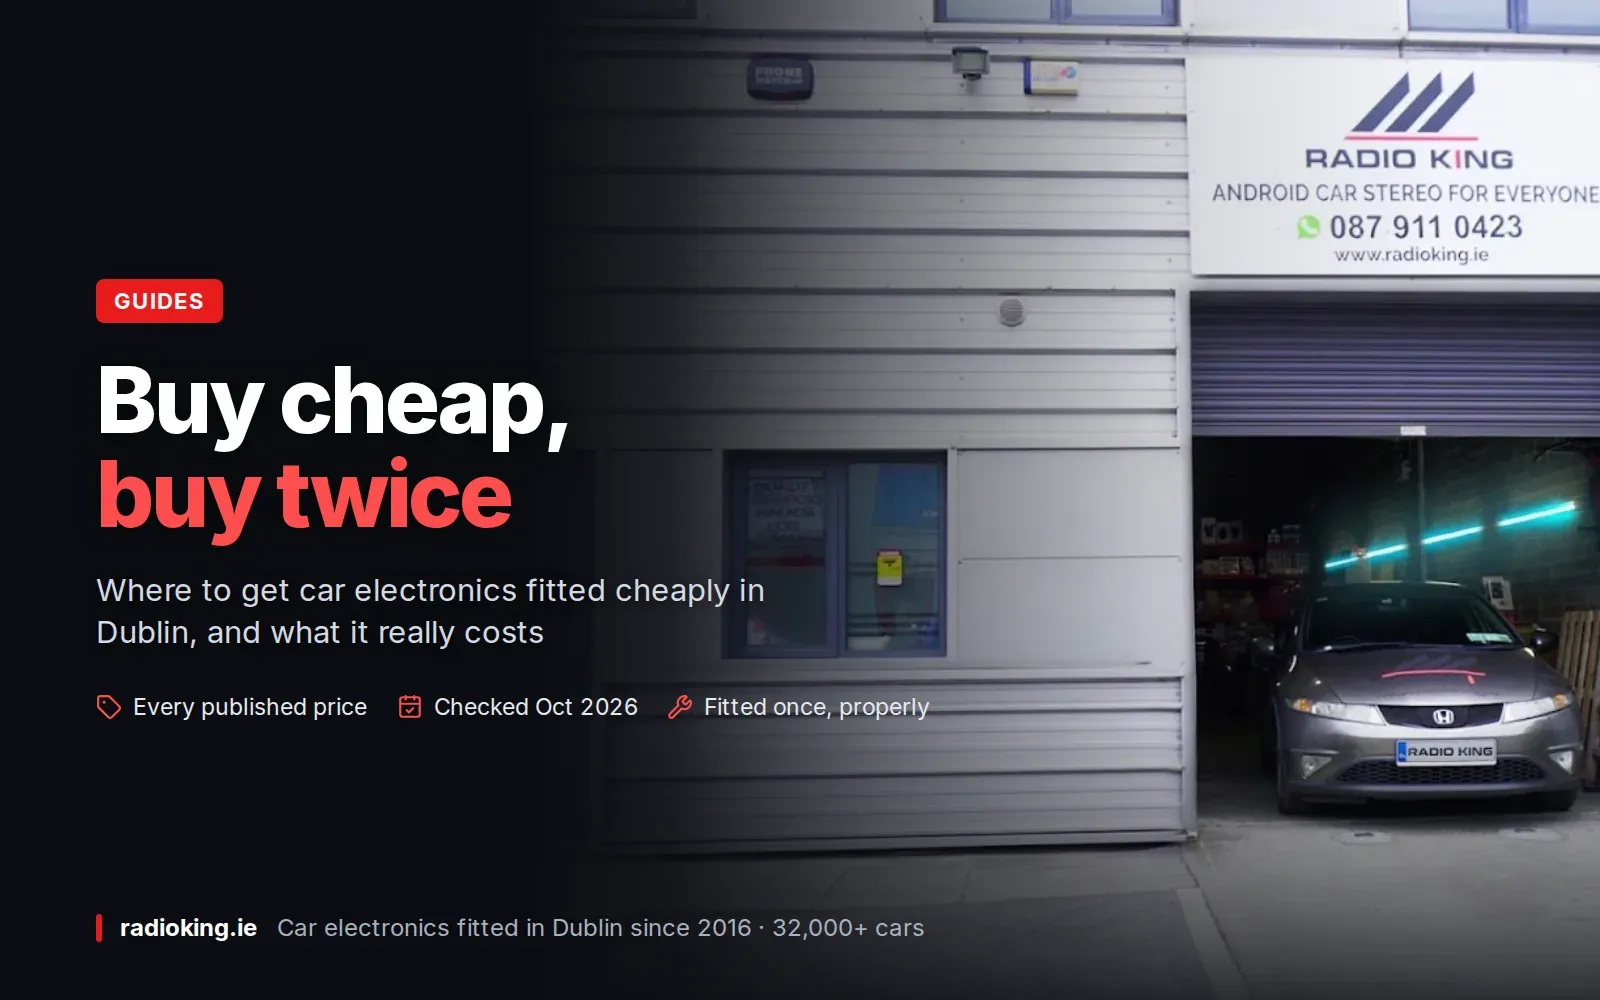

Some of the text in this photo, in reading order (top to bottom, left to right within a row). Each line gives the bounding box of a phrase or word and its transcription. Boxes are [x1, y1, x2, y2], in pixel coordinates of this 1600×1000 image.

[1305, 148, 1514, 170] RADIO KING
[1211, 183, 1600, 204] ANDROID CAR STEREO FOR EVERYONE
[1330, 214, 1523, 240] 087 911 0423
[1334, 246, 1489, 266] www.radioking.ie
[1407, 746, 1494, 757] RADIO KING
